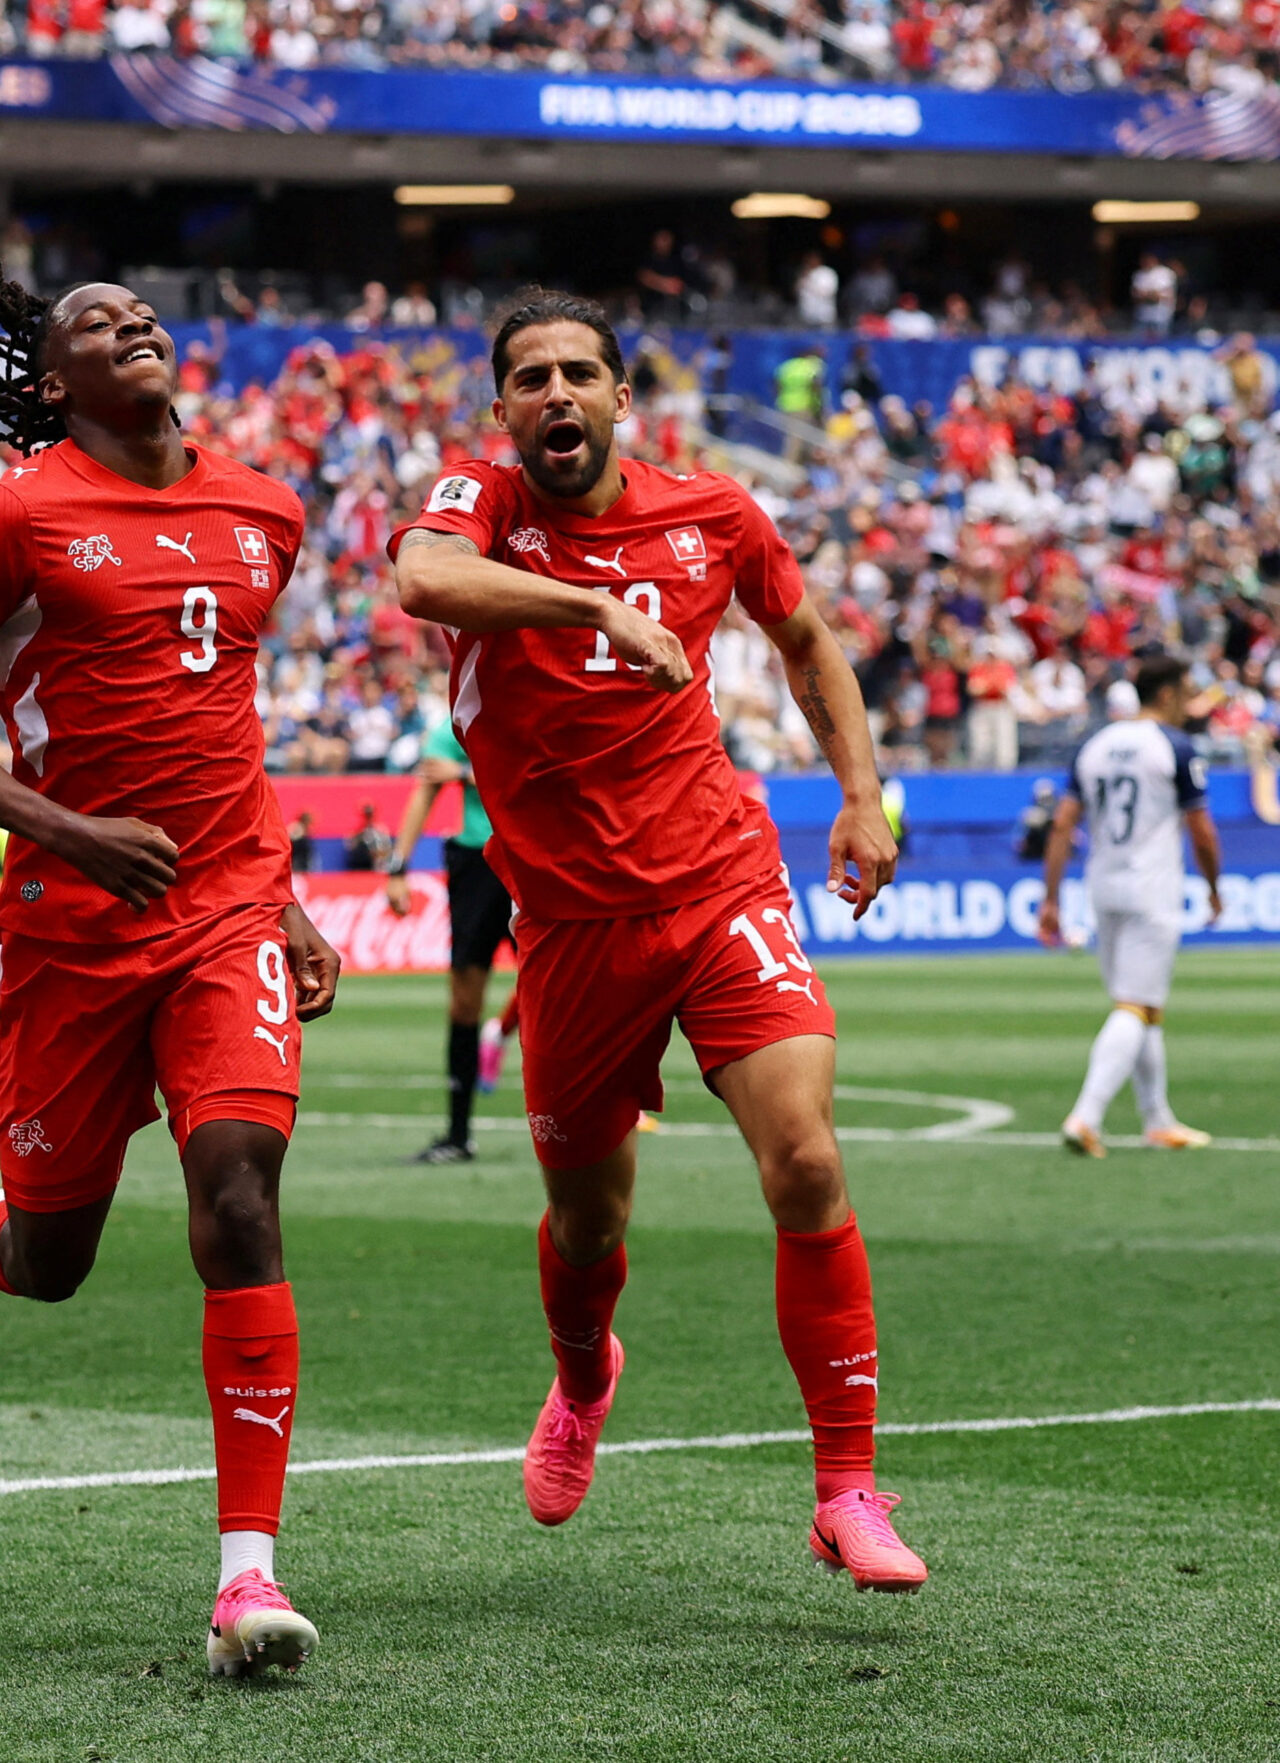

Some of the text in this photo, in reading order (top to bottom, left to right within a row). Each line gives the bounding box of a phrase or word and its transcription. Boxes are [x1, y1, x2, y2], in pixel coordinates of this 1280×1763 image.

[180, 586, 217, 672] 9
[1096, 775, 1138, 845] 13
[728, 908, 814, 983] 13
[805, 879, 1006, 943] WORLD
[256, 940, 288, 1025] 9
[223, 1386, 291, 1397] suisse
[828, 1349, 878, 1367] suiss
